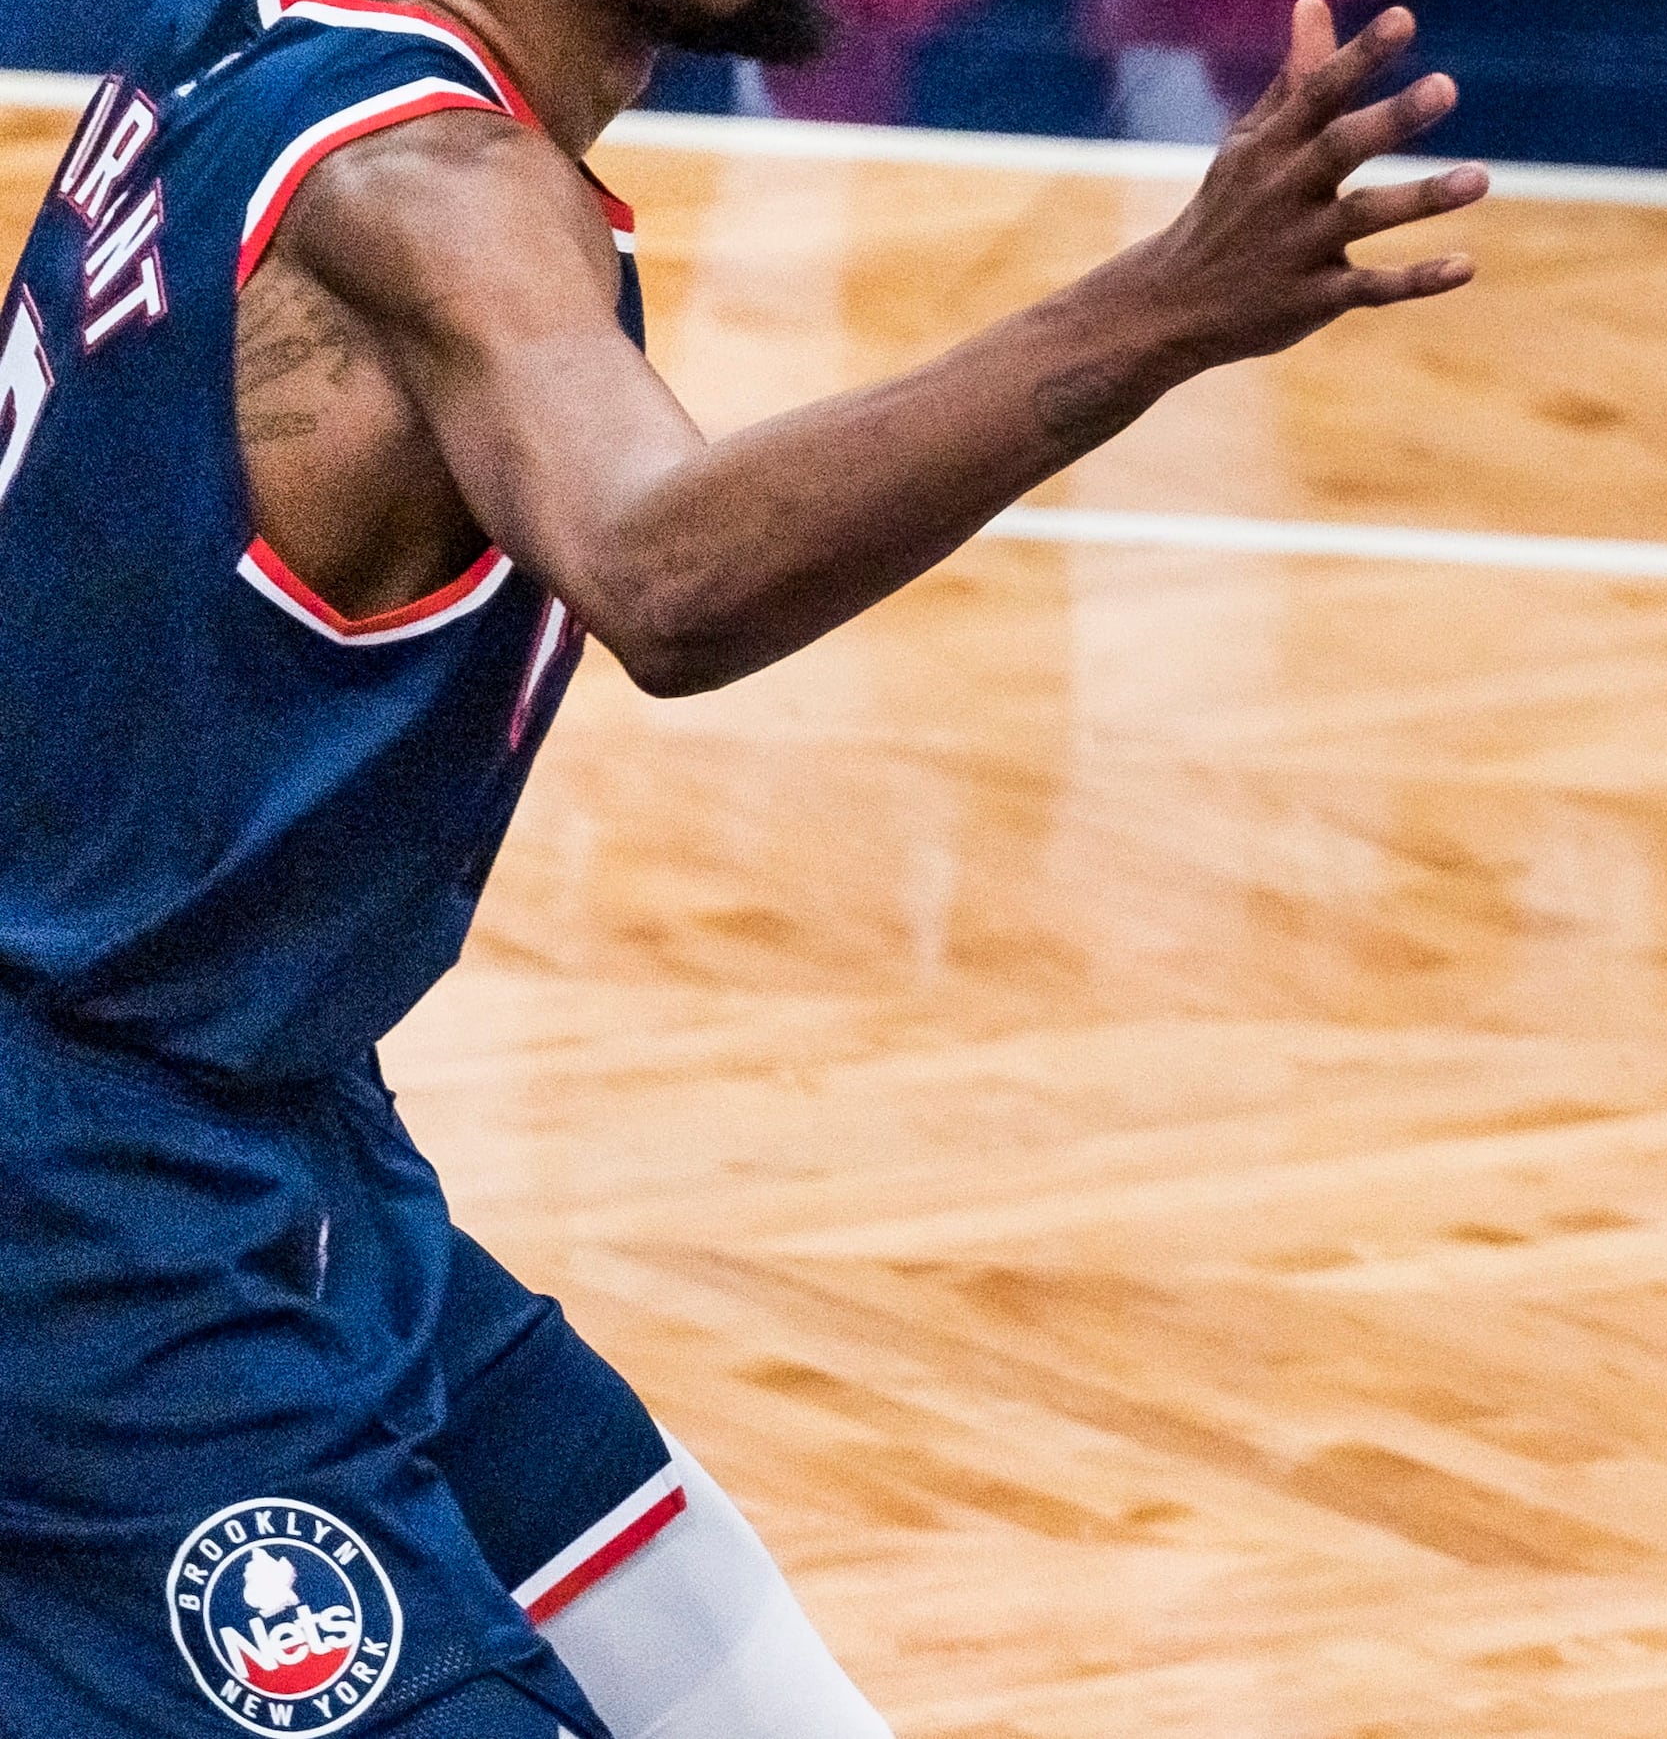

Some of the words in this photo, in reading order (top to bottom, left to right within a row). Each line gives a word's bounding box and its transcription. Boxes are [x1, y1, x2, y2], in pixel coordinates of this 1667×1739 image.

[58, 75, 168, 353] URNT
[178, 1510, 360, 1612] BROOKLYN
[219, 1604, 359, 1681] Nets
[219, 1678, 295, 1728] NEW
[312, 1636, 389, 1719] YORK
